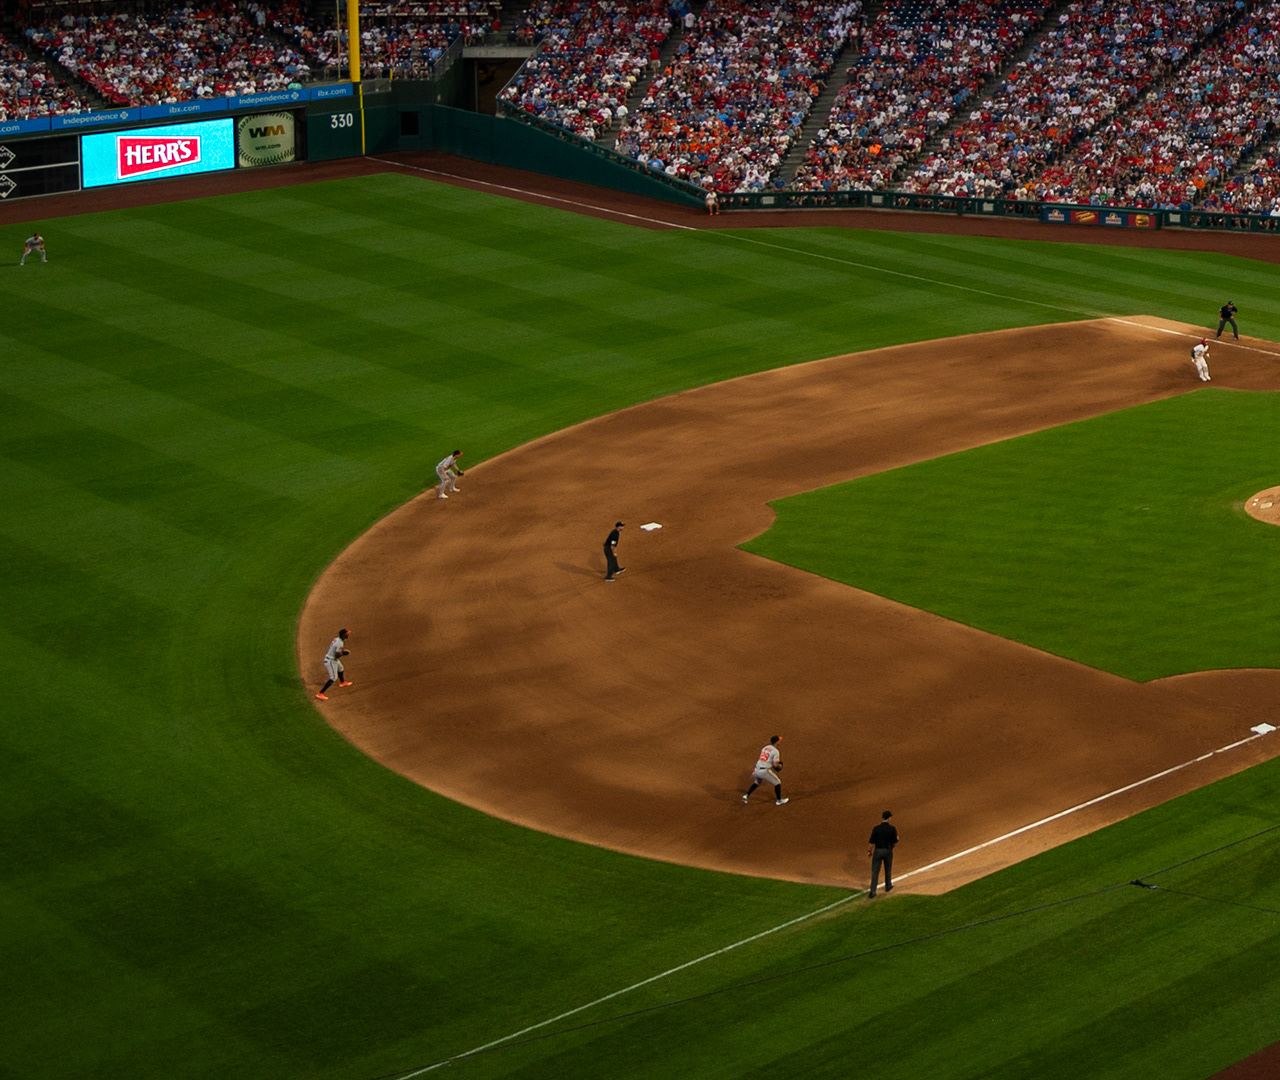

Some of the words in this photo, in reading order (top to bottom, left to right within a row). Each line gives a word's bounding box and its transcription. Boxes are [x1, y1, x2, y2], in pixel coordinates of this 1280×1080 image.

[238, 93, 291, 105] Independence
[317, 87, 347, 98] ibx.com
[168, 103, 201, 115] ibx.com
[62, 112, 119, 126] Independence
[330, 113, 354, 130] 330
[249, 123, 286, 140] WM
[124, 138, 192, 167] HERR'S
[255, 141, 282, 151] wm.com
